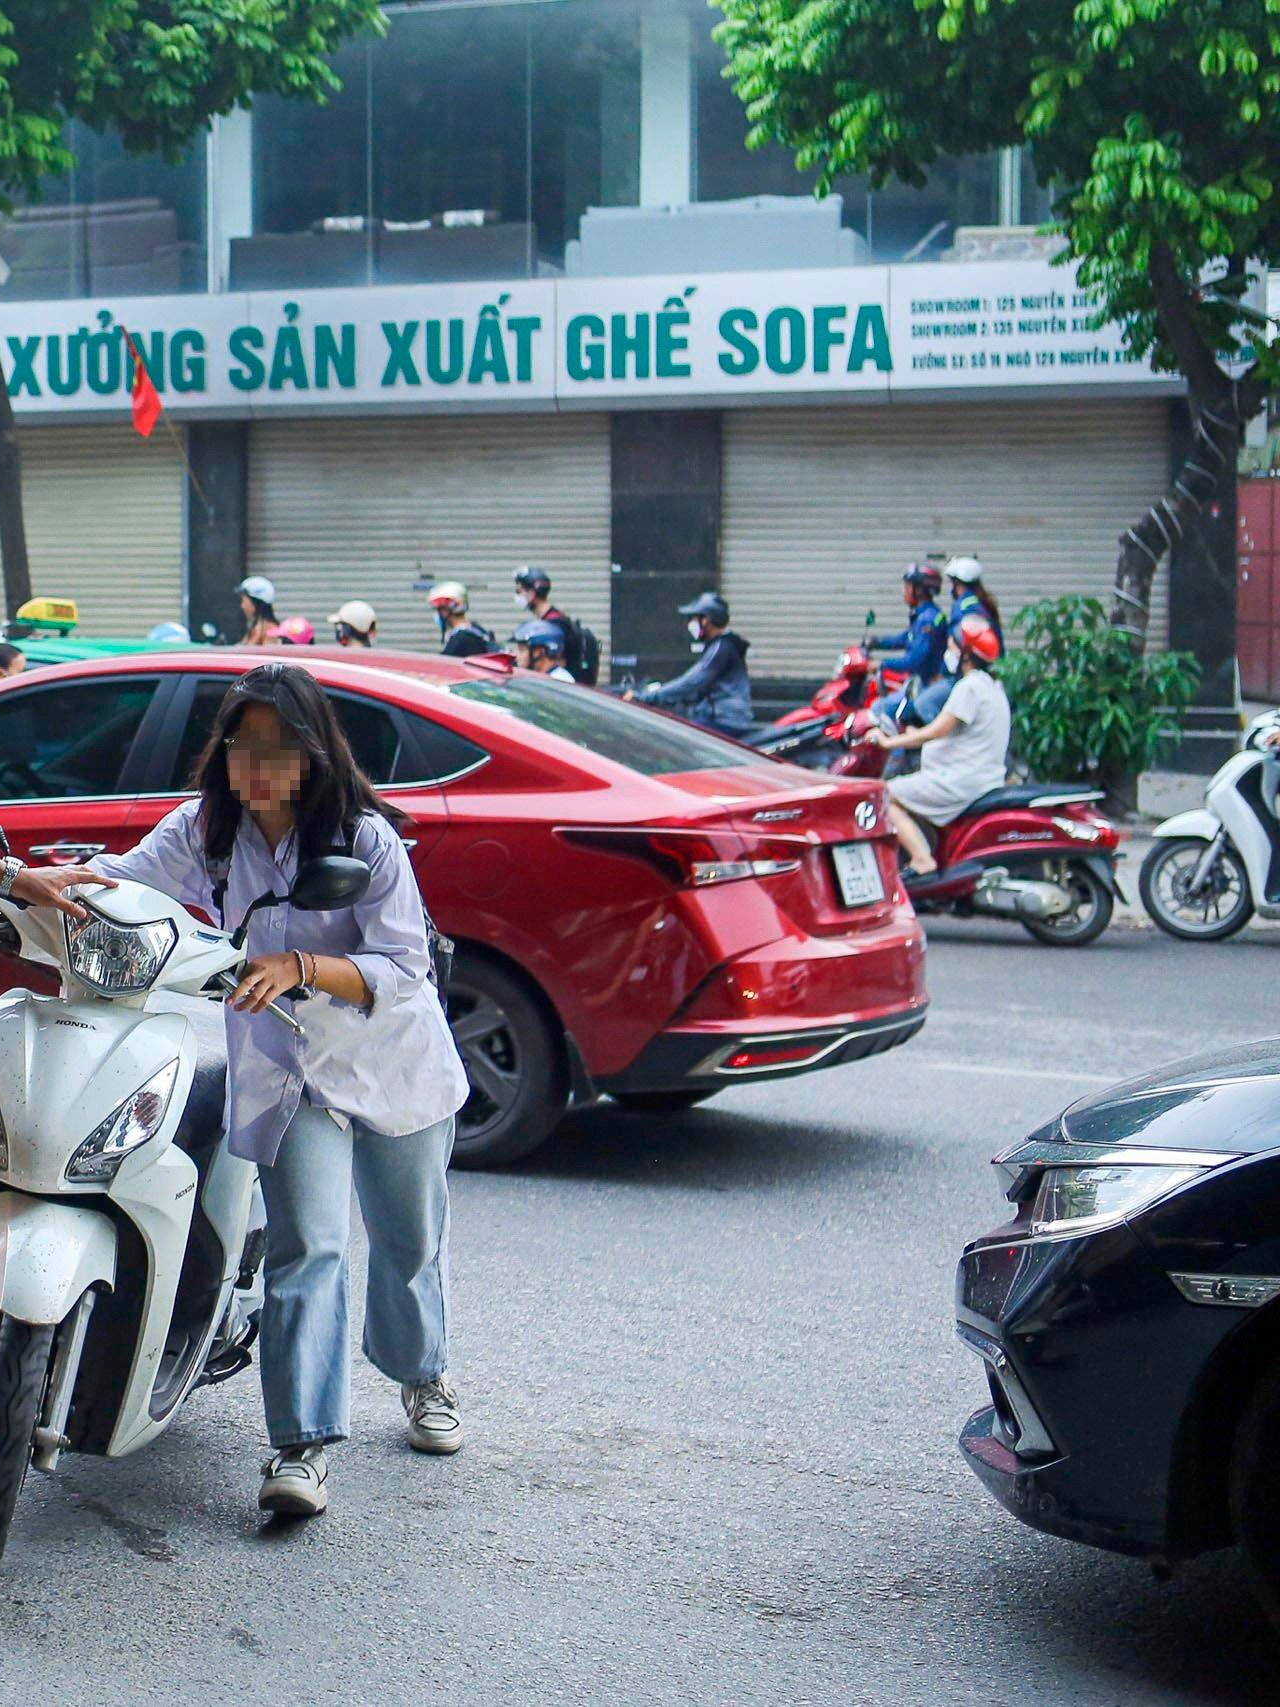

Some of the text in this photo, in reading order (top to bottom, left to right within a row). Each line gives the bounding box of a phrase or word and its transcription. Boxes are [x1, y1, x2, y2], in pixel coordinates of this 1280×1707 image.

[911, 297, 980, 314] SHOWROOM
[911, 321, 977, 338] SHOWROOM
[5, 286, 894, 398] XƯỞNG SẢN XUẤT GHẾ SOFA
[55, 1019, 97, 1031] HONDA
